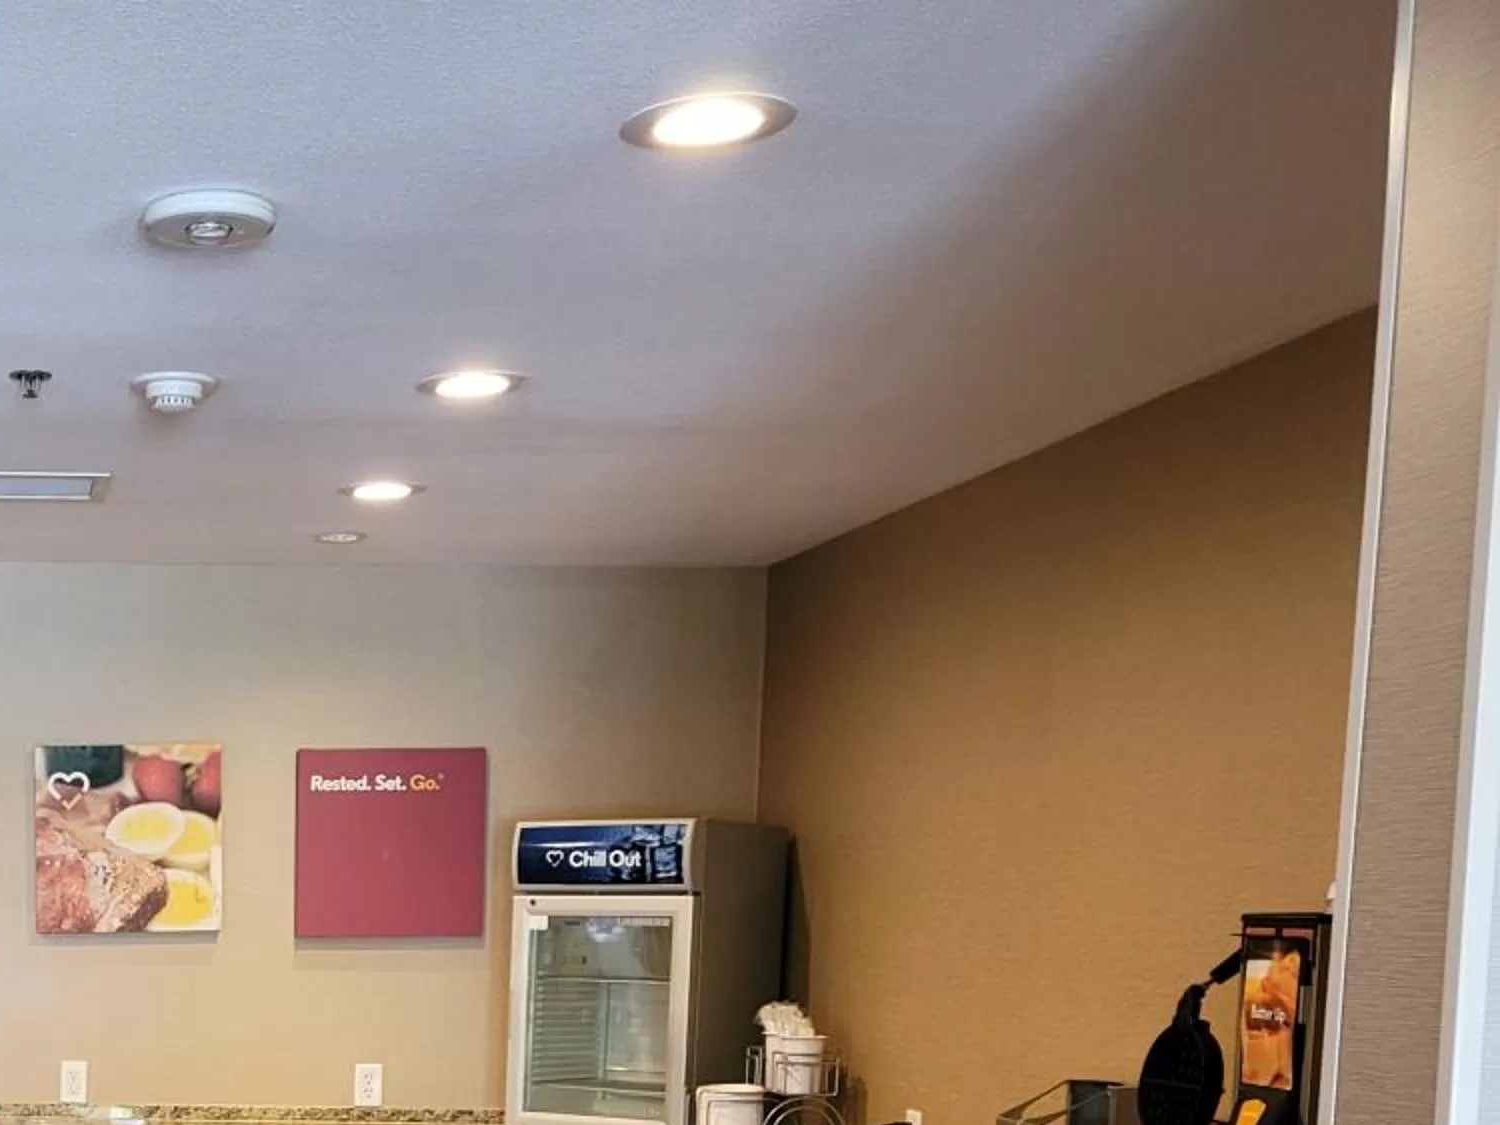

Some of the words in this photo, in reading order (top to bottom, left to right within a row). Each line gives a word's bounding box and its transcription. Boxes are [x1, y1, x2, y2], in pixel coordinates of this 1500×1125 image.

[310, 774, 372, 791] Rested.
[375, 774, 407, 791] Set.
[569, 850, 607, 868] Chill
[609, 849, 642, 867] Out
